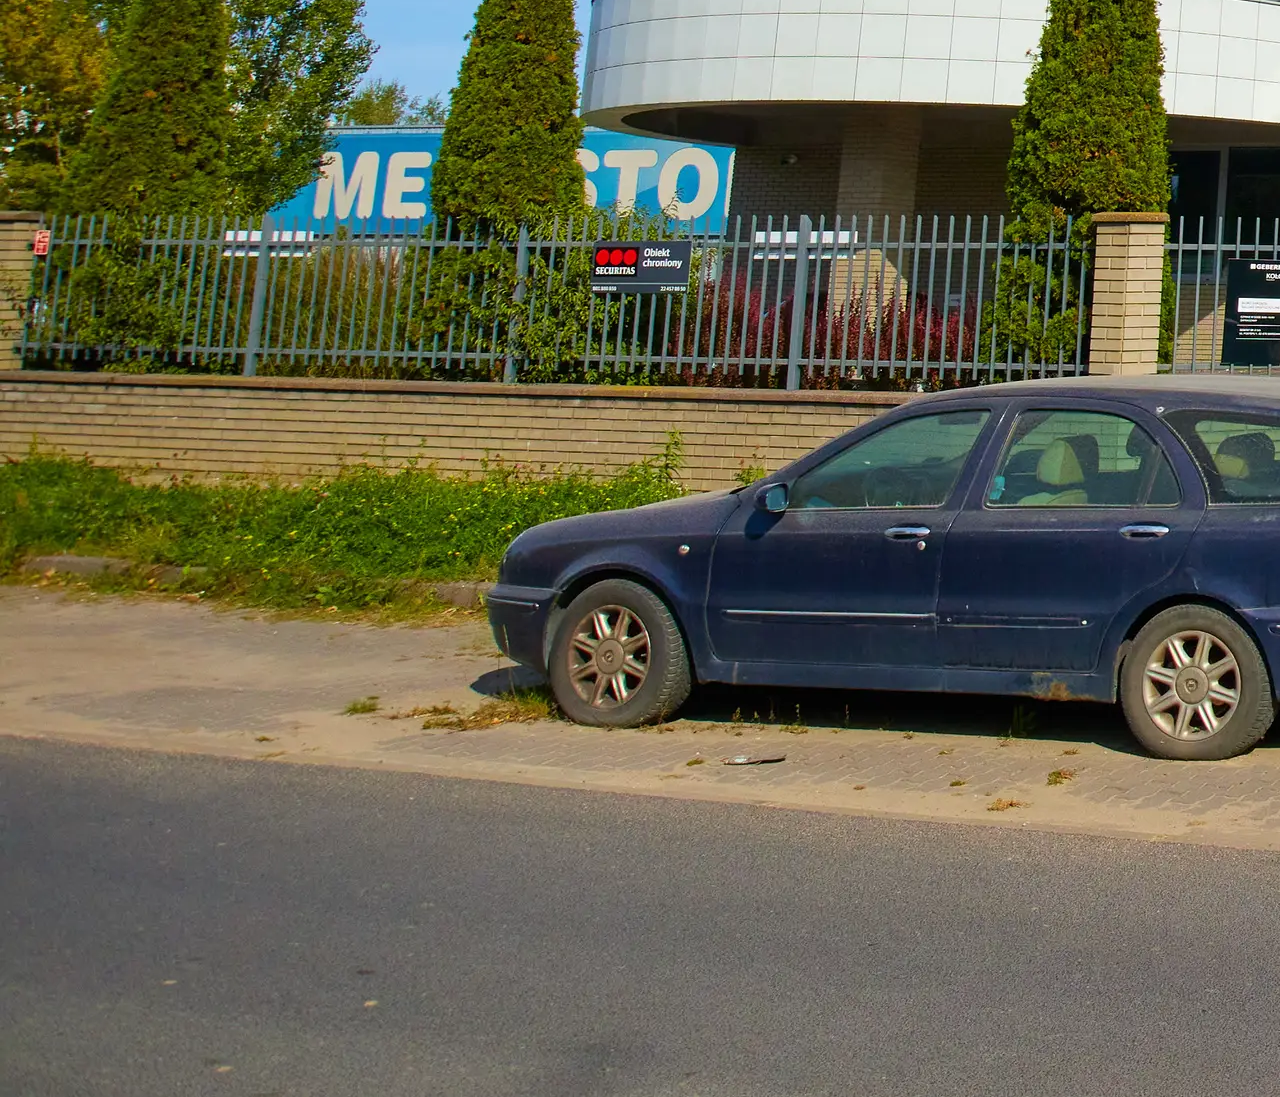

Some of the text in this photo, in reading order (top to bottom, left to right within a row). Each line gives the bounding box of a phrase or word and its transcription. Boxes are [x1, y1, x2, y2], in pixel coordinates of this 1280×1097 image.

[643, 247, 670, 257] Obiekt
[642, 258, 682, 269] chroniony
[595, 266, 636, 275] SECURITAS
